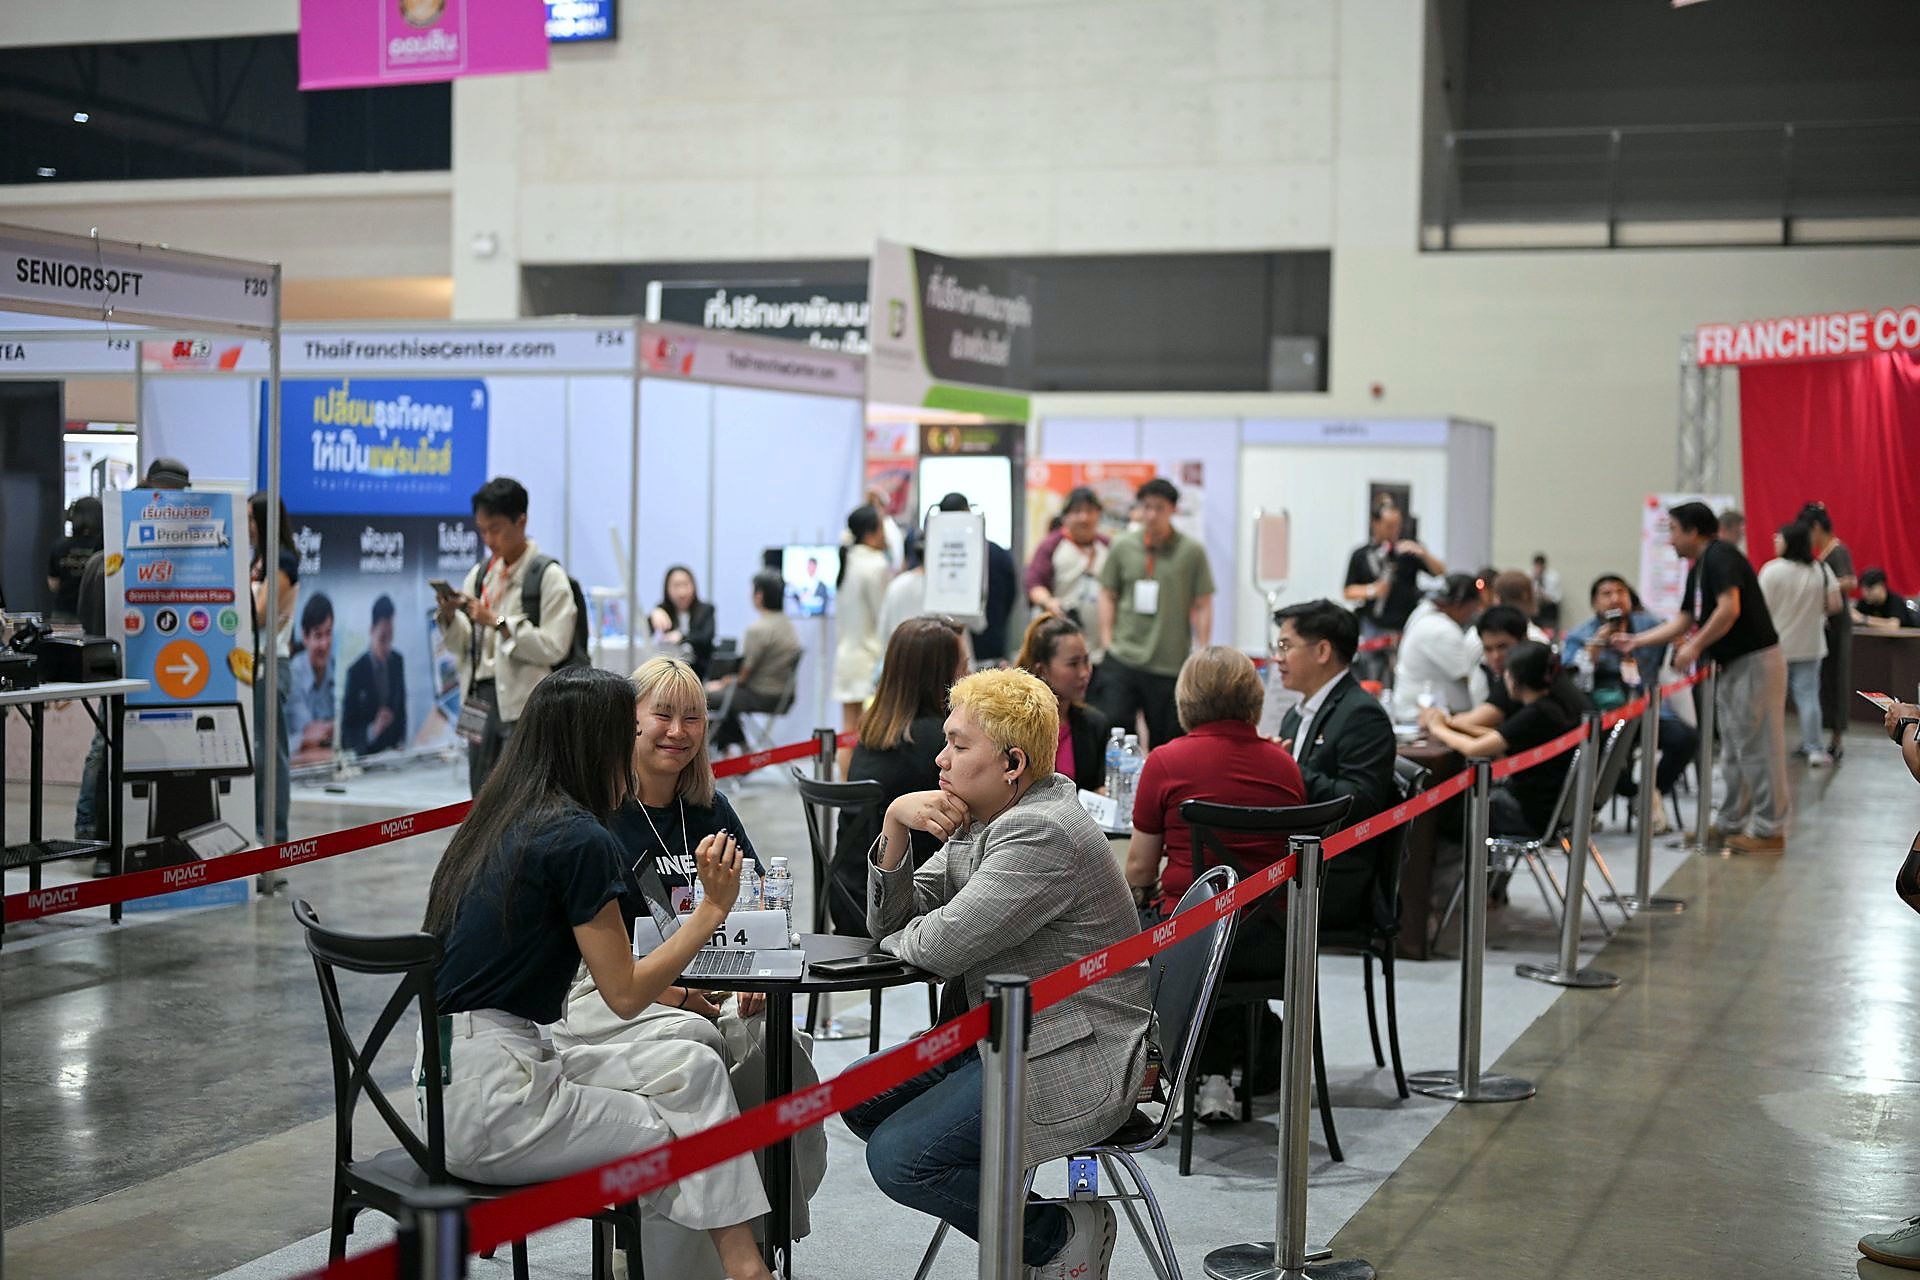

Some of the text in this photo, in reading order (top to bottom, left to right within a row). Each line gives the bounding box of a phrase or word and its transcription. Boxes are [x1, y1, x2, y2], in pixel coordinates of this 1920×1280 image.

[16, 257, 143, 297] SENIORSOFT
[244, 277, 268, 297] F30
[1698, 308, 1920, 362] FRANCHISE CO
[305, 341, 555, 359] ThaiFranchiseCenter.com
[381, 818, 414, 837] IMPACT
[280, 840, 318, 862] IMPACT
[164, 864, 207, 887] IMPACT
[28, 888, 78, 912] IMPACT
[733, 929, 748, 946] 4
[1153, 921, 1177, 947] IMPACT
[1080, 953, 1108, 981] IMPACT
